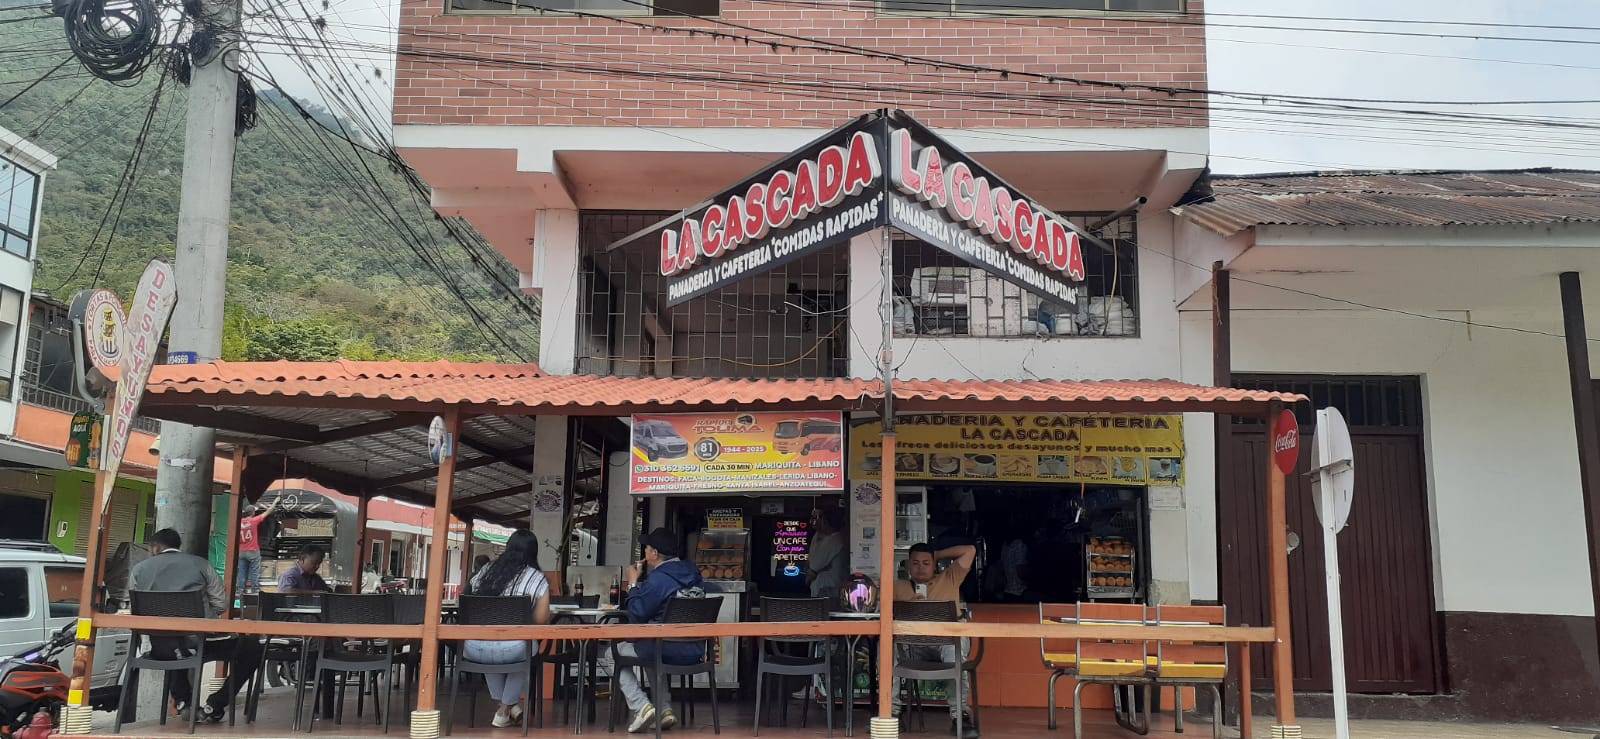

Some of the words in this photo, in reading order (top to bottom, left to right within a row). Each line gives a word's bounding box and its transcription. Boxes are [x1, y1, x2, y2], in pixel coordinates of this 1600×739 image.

[661, 218, 699, 276] LA
[701, 131, 878, 257] CASCADA
[893, 128, 947, 207] LA
[949, 162, 1085, 281] CASCADA
[893, 198, 949, 245] PANADERIA
[949, 229, 958, 246] Y
[958, 234, 1006, 272] CAFETERIA
[669, 269, 714, 300] PANADERIA
[714, 263, 722, 282] Y
[721, 245, 772, 279] CAFETERIA
[88, 292, 104, 321] TORTAS
[113, 268, 167, 459] DESAYUNOS
[895, 414, 1005, 426] NADERIA
[1013, 415, 1026, 427] Y
[1034, 415, 1170, 429] CAFETERIA
[693, 424, 764, 434] TOLIMA
[961, 427, 985, 440] LA
[989, 428, 1080, 441] CASCADA
[700, 442, 713, 453] 81
[895, 440, 931, 449] frece
[934, 440, 1004, 450] deliciosos
[1006, 442, 1080, 451] desayunos
[1084, 444, 1093, 453] y
[1095, 445, 1142, 453] mucho
[1144, 445, 1173, 453] mas
[644, 465, 659, 473] 310
[755, 461, 802, 470] MARIQUITA
[808, 460, 840, 468] LIBANO
[240, 529, 253, 543] 14
[773, 553, 809, 561] APETECE
